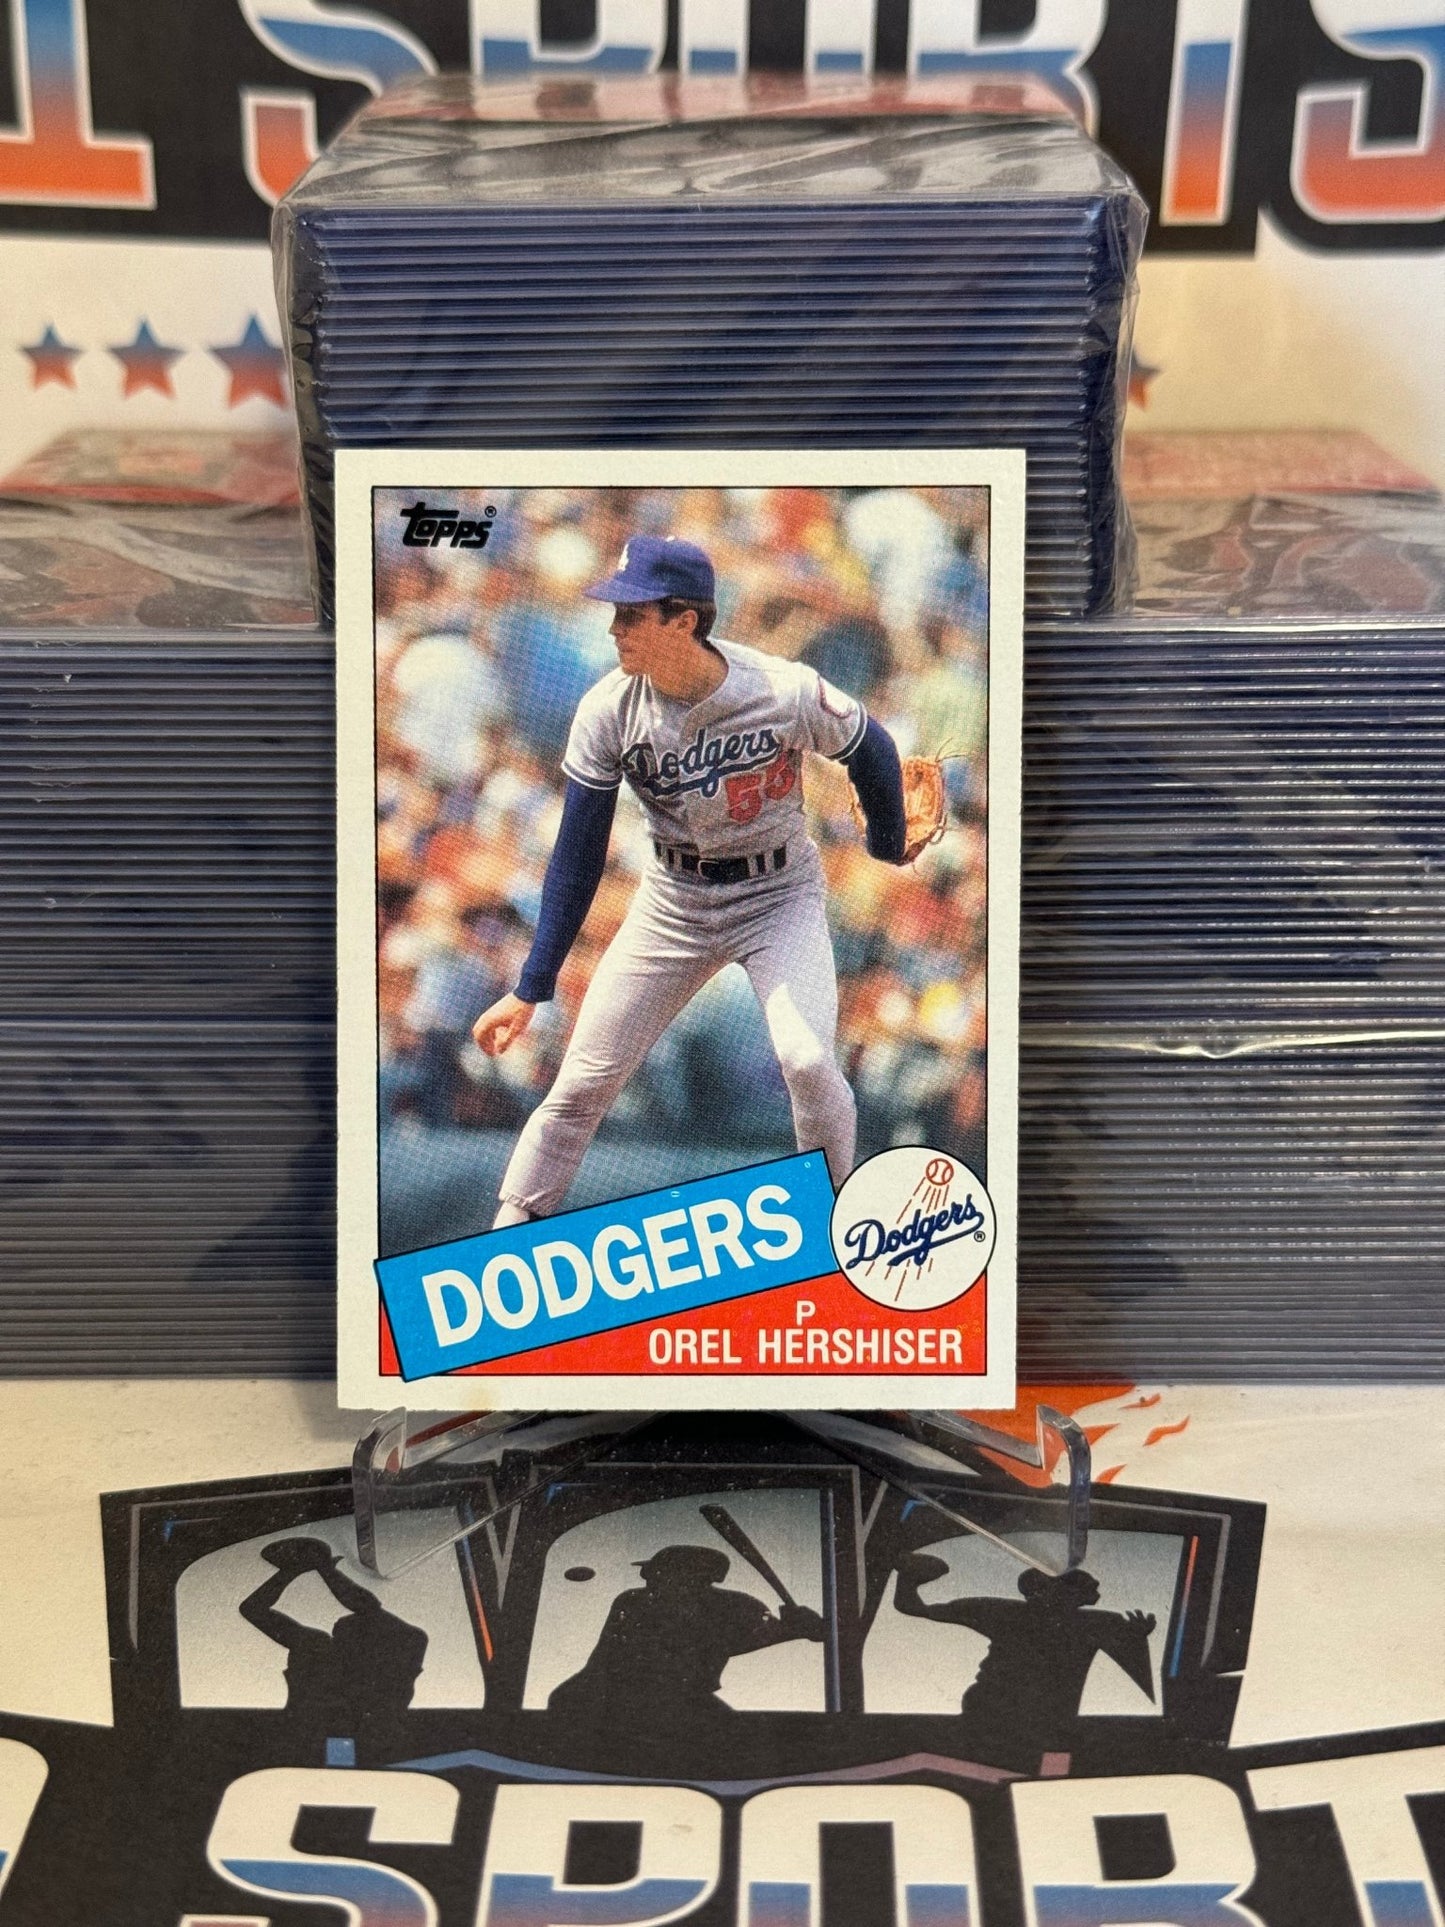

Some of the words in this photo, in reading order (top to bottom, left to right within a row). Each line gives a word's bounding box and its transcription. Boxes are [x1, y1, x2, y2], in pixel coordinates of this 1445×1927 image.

[621, 729, 781, 798] Dodgers
[422, 1185, 803, 1348] DODGERS
[844, 1194, 984, 1270] Dodgers
[649, 1328, 742, 1364] OREL
[758, 1328, 963, 1364] HERSHISER
[796, 1300, 816, 1326] P
